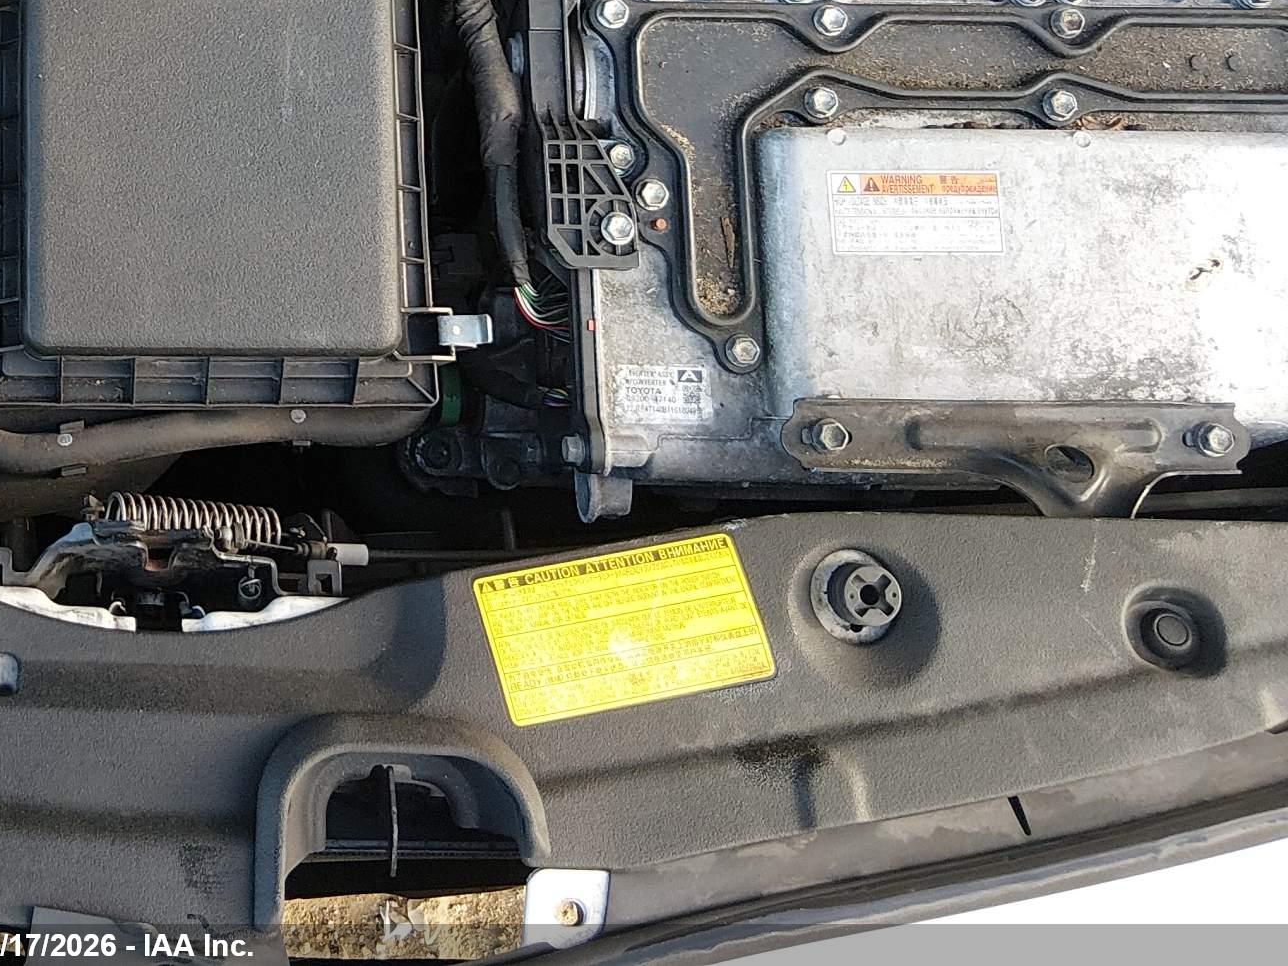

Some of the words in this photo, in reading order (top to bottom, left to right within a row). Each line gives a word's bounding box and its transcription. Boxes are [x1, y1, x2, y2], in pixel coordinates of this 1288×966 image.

[881, 175, 923, 184] WARNING
[881, 184, 934, 194] AVERTISSEMENT
[626, 387, 662, 395] TOYOTA
[524, 565, 580, 585] CAUTION
[585, 552, 654, 574] ATTENTION
[658, 538, 726, 560] ВНИМАНИЕ
